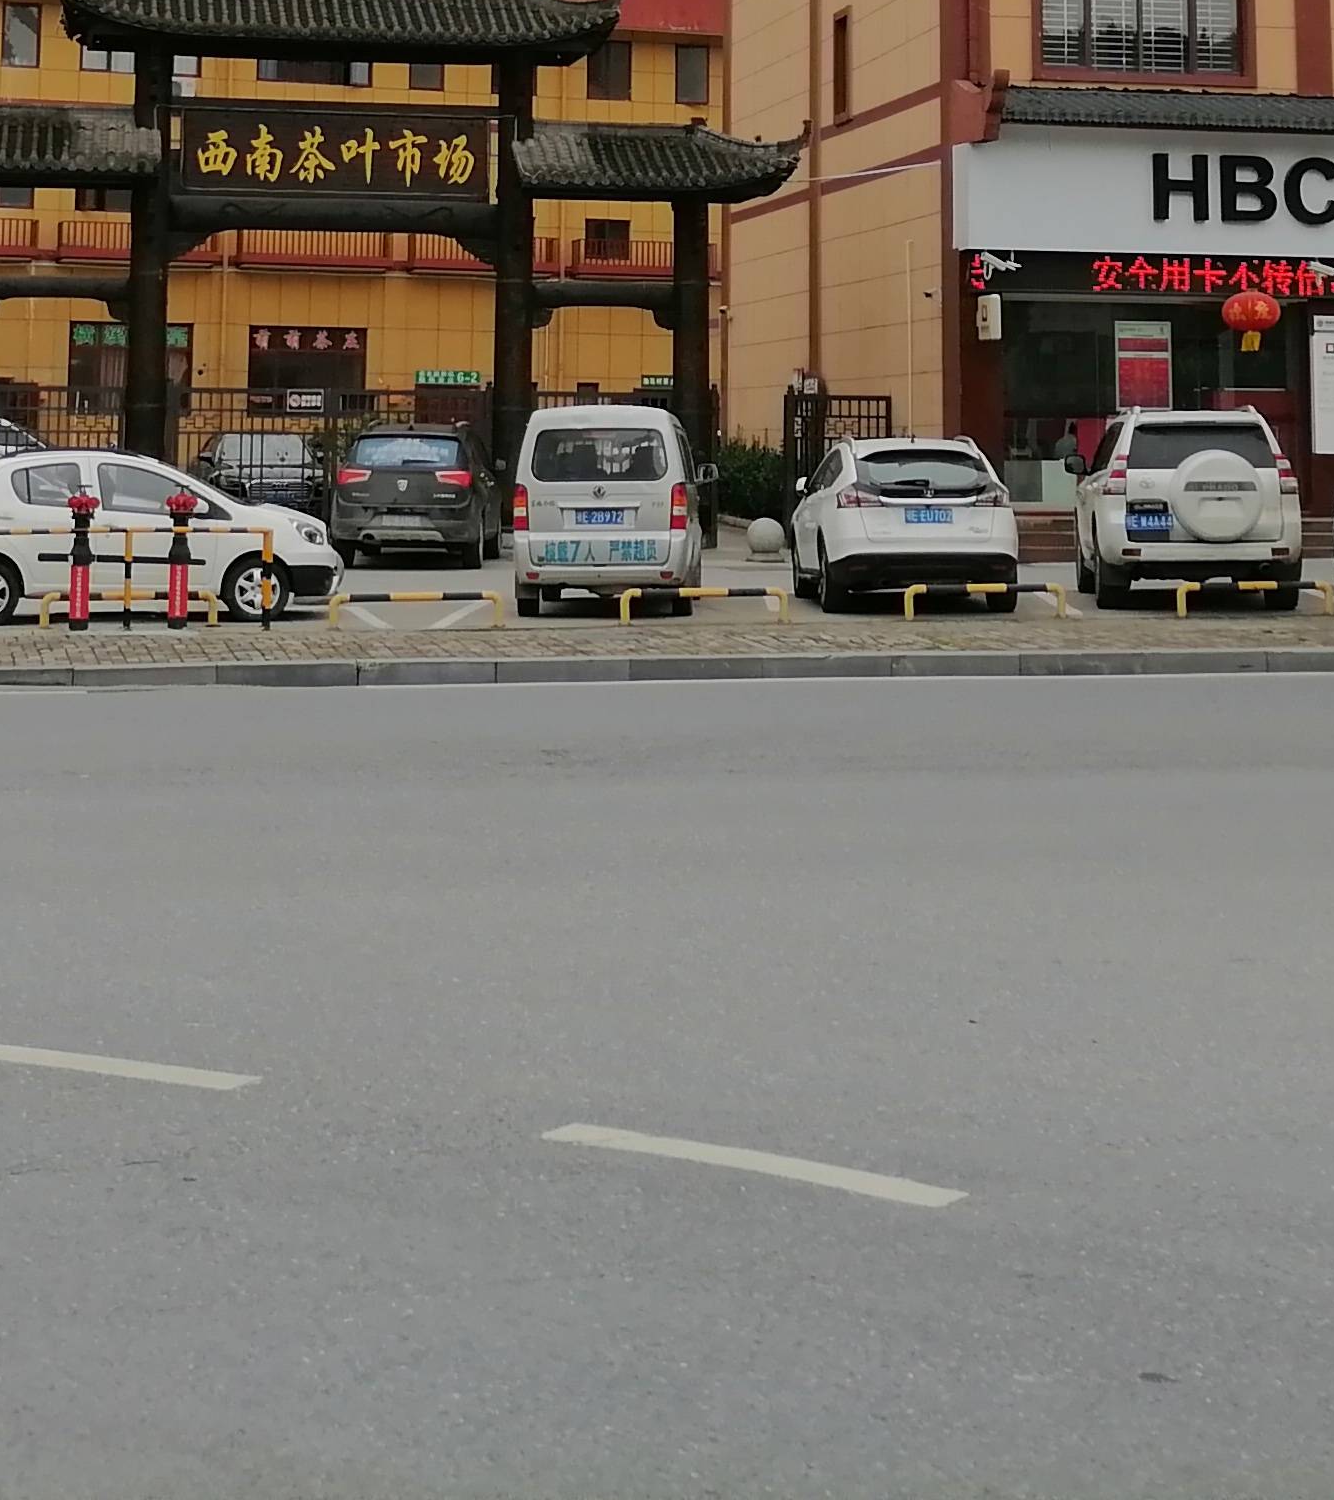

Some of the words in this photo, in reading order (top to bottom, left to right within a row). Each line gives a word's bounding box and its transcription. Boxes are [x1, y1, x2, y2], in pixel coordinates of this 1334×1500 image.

[197, 124, 475, 186] 西南茶叶市场
[608, 540, 657, 562] 严禁超员
